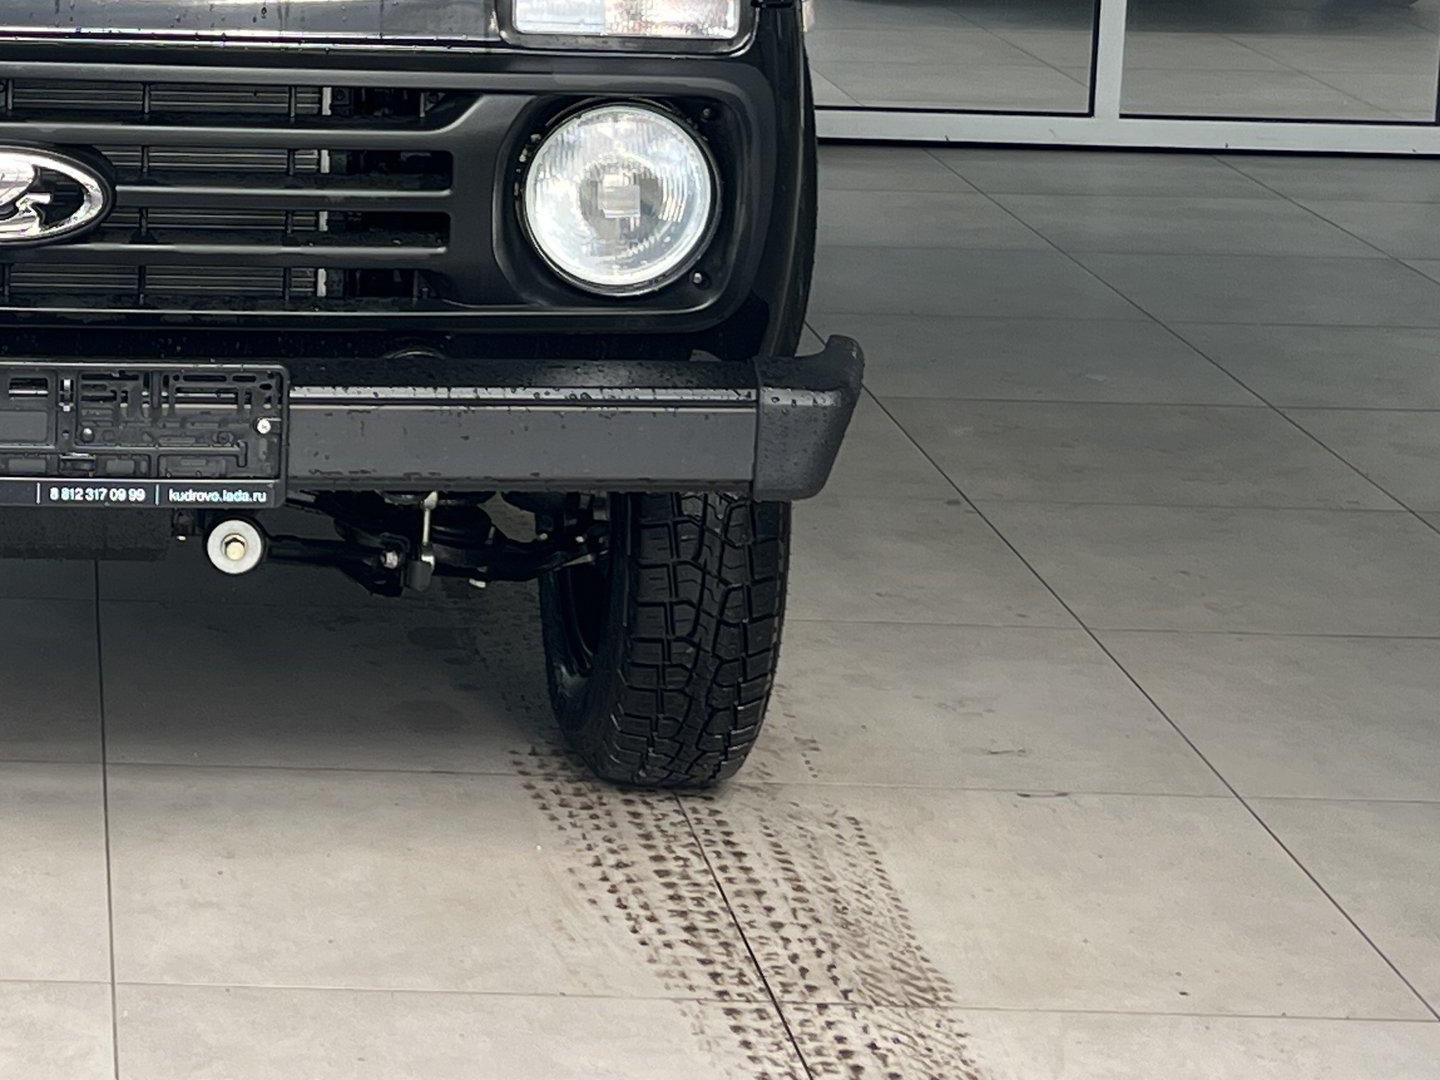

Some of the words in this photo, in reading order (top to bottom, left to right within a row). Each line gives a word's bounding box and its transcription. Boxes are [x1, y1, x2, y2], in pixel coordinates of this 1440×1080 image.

[49, 487, 59, 501] 8
[61, 487, 84, 501] 812
[85, 488, 108, 501] 317
[109, 488, 127, 502] 09
[128, 488, 146, 502] 99
[168, 488, 268, 503] kudrovo.lada.ru
